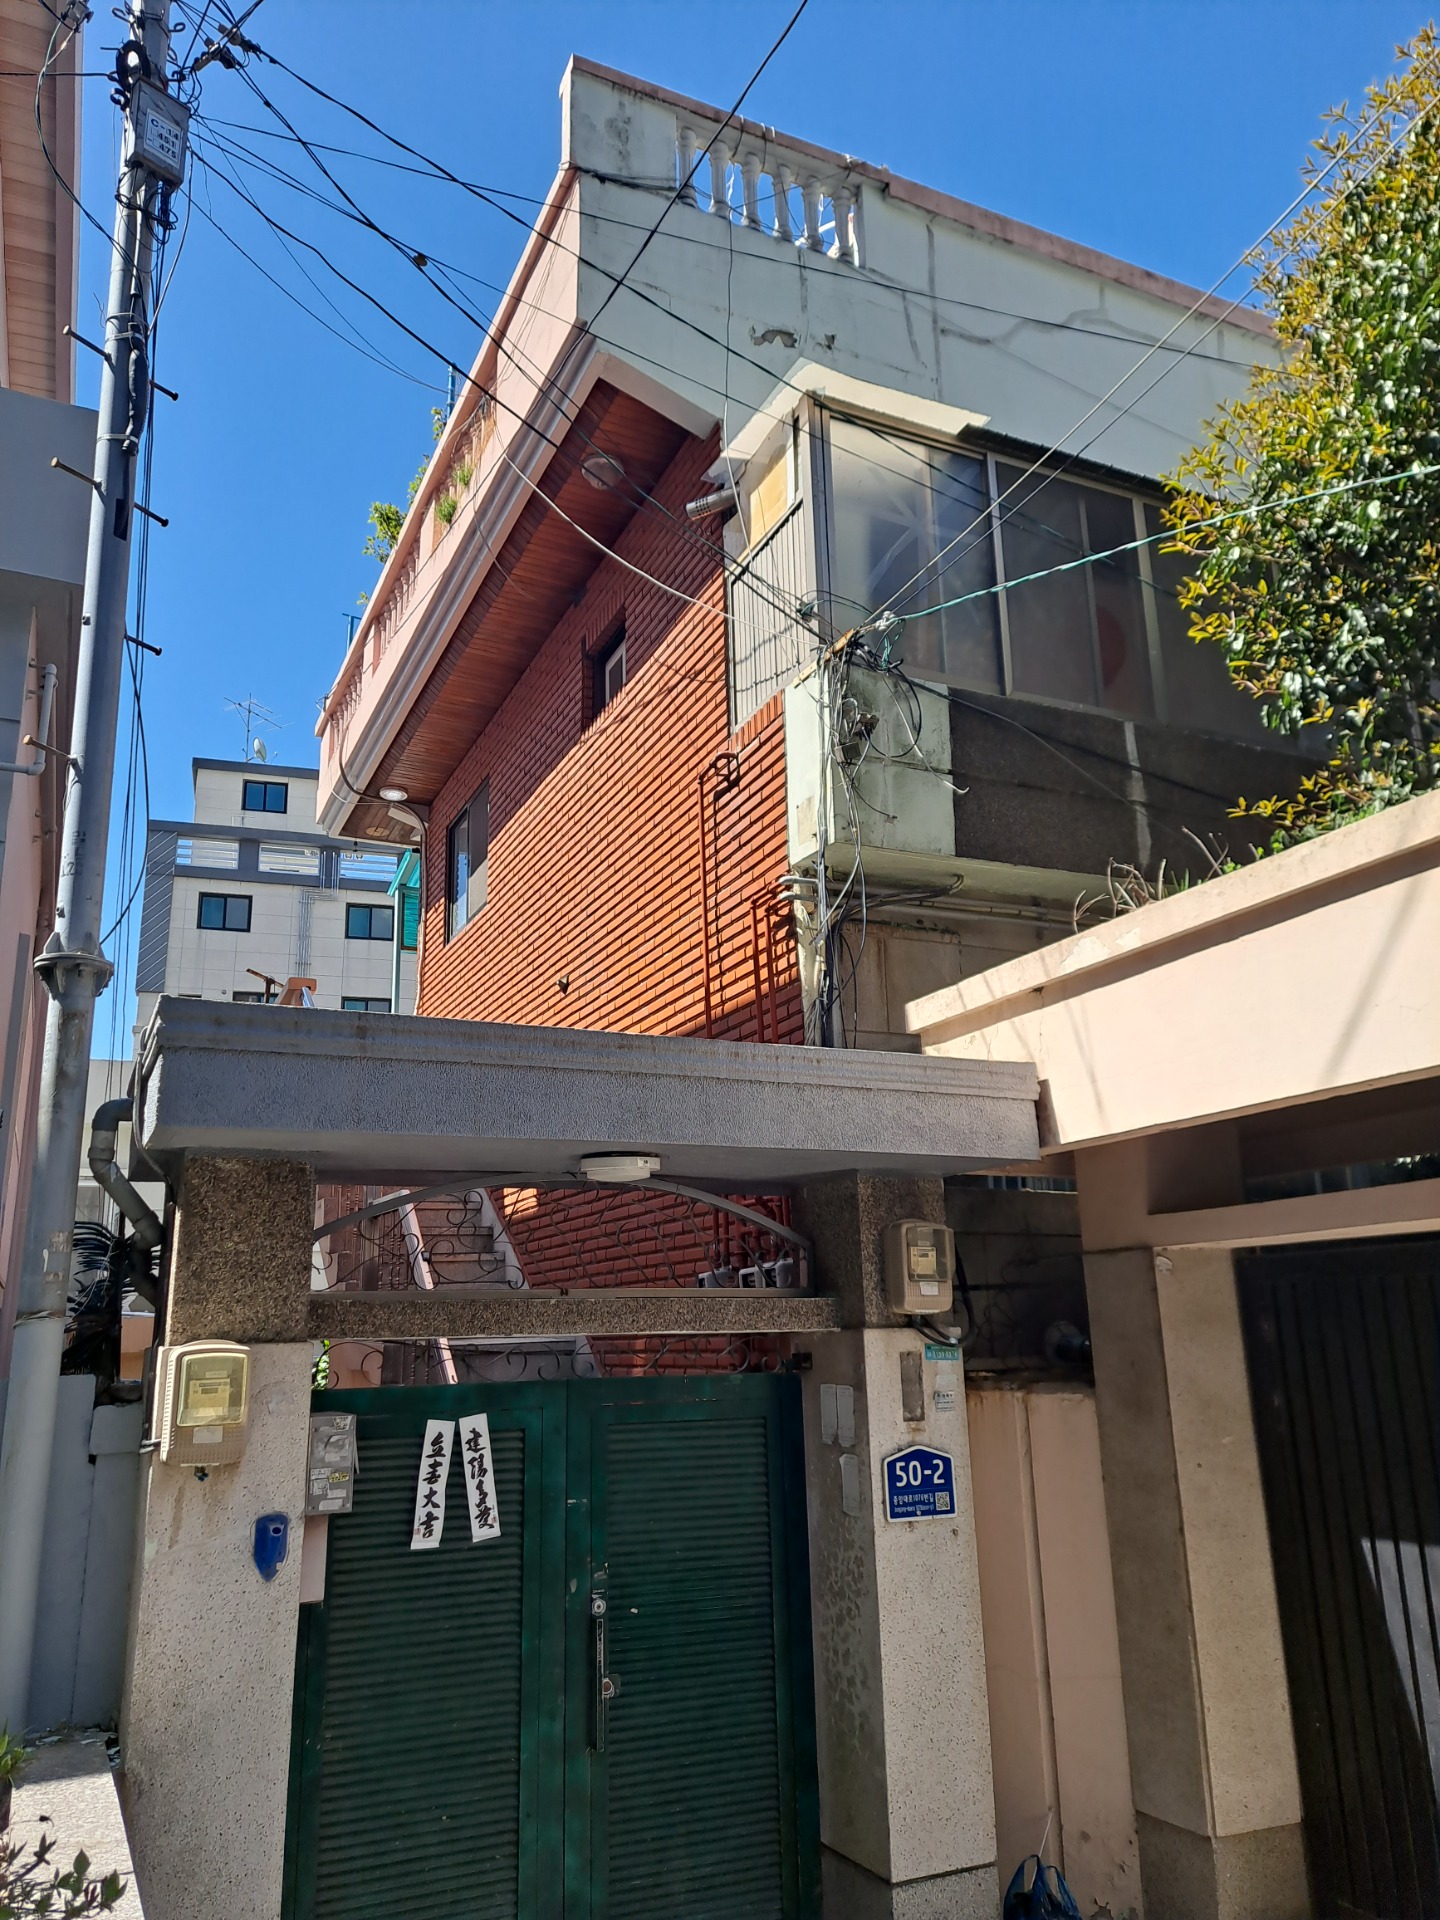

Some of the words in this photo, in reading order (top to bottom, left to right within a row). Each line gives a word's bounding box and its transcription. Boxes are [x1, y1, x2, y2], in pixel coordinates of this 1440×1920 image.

[150, 118, 179, 141] C-14
[158, 132, 176, 148] 451
[895, 1459, 945, 1487] 50-2
